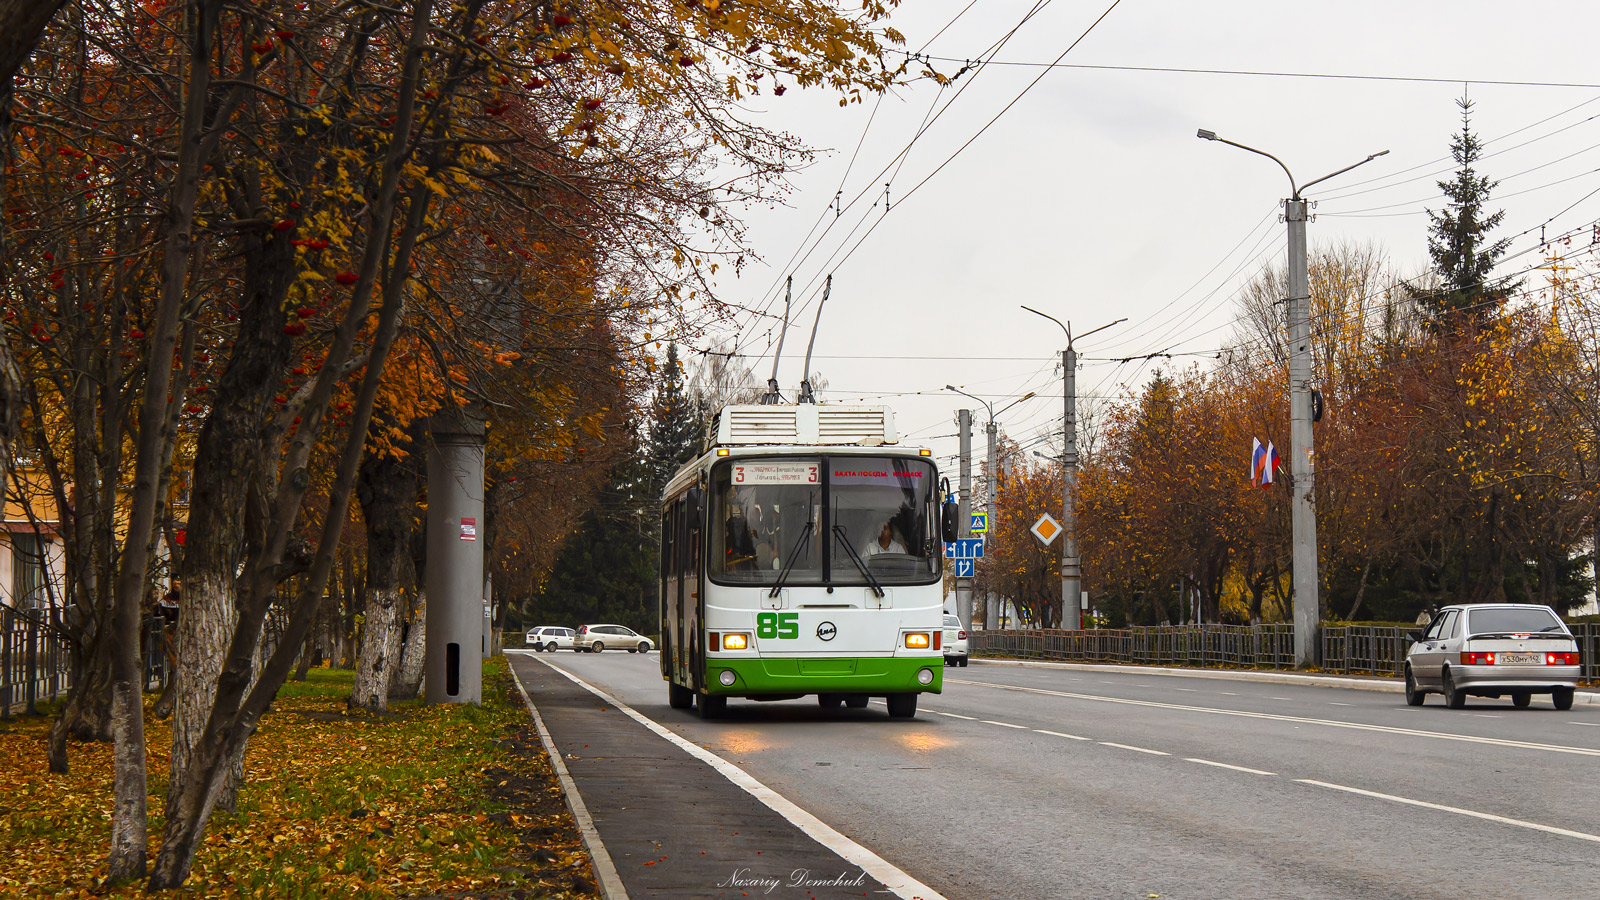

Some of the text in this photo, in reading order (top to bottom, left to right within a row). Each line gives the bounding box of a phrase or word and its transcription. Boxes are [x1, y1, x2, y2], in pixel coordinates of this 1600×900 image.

[735, 467, 745, 482] 3
[808, 467, 817, 482] 3
[757, 612, 798, 639] 85
